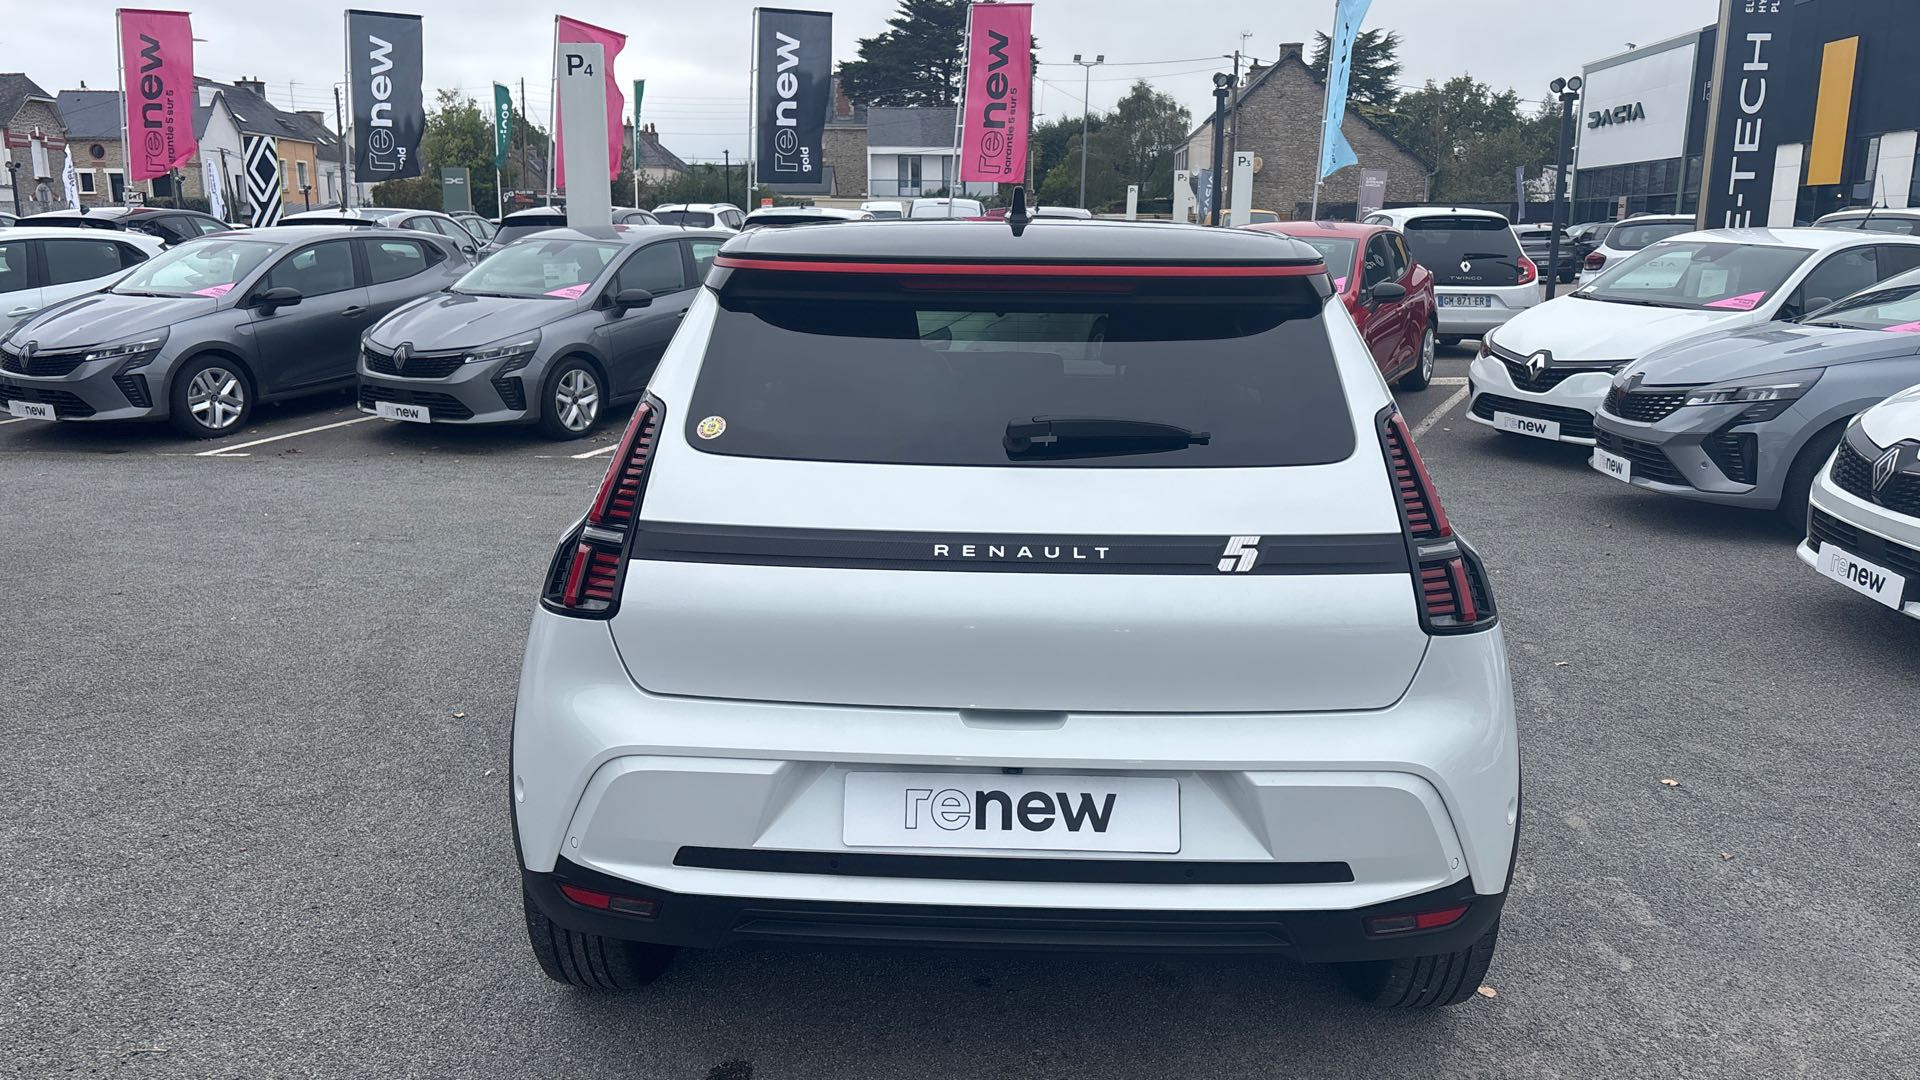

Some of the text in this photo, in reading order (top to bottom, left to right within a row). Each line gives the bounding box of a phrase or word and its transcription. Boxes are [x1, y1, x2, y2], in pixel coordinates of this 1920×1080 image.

[139, 34, 166, 174] renew
[369, 35, 395, 171] renew
[775, 32, 800, 172] renew
[978, 30, 1009, 174] renew
[1588, 102, 1645, 128] DACIA
[1004, 126, 1014, 174] garantie
[1724, 33, 1772, 228] E-TECH
[800, 147, 811, 172] gold
[1504, 416, 1546, 434] renew
[933, 536, 1261, 573] RENAULT 5
[1830, 553, 1887, 594] renew
[904, 788, 1118, 833] renew
